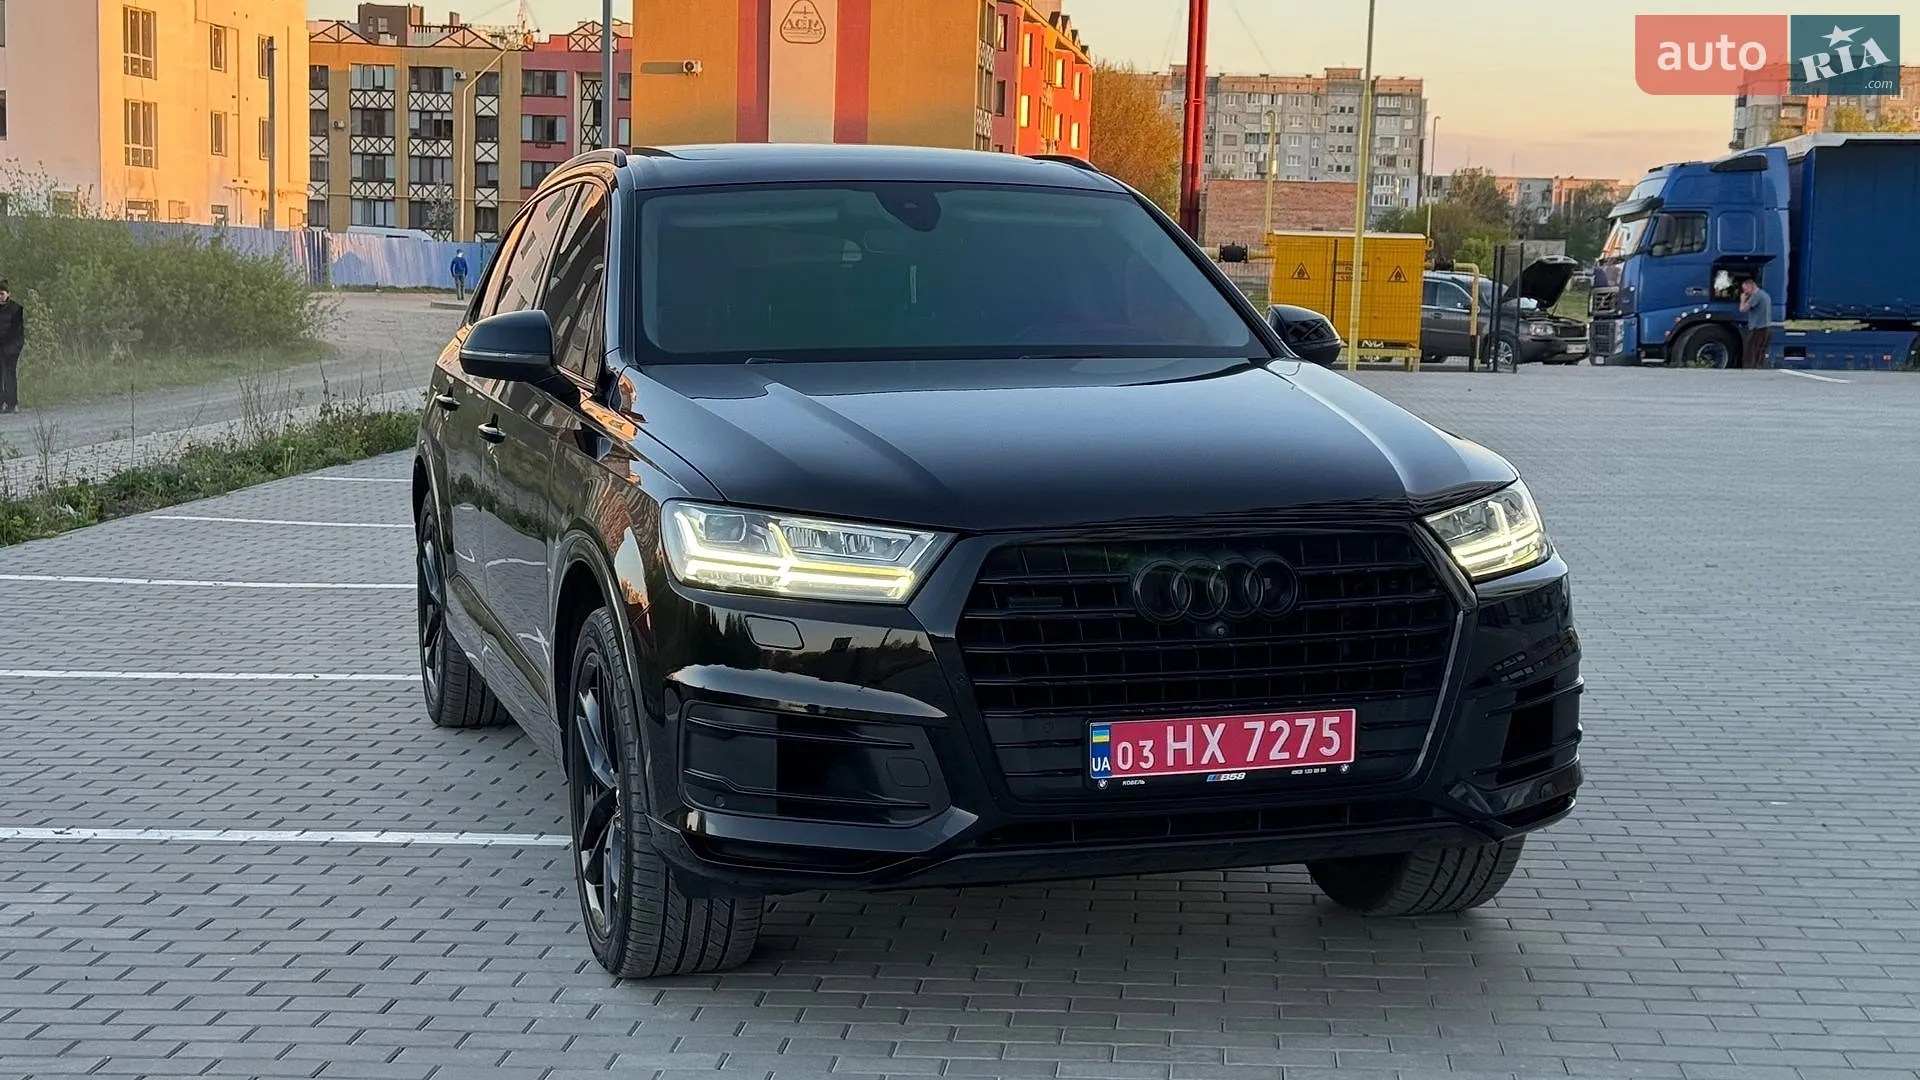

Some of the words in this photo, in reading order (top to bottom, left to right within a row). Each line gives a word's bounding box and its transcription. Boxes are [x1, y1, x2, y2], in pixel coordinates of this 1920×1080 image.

[1117, 740, 1155, 770] 03
[1167, 723, 1226, 766] HX
[1243, 716, 1341, 762] 7275
[1092, 757, 1111, 772] UA
